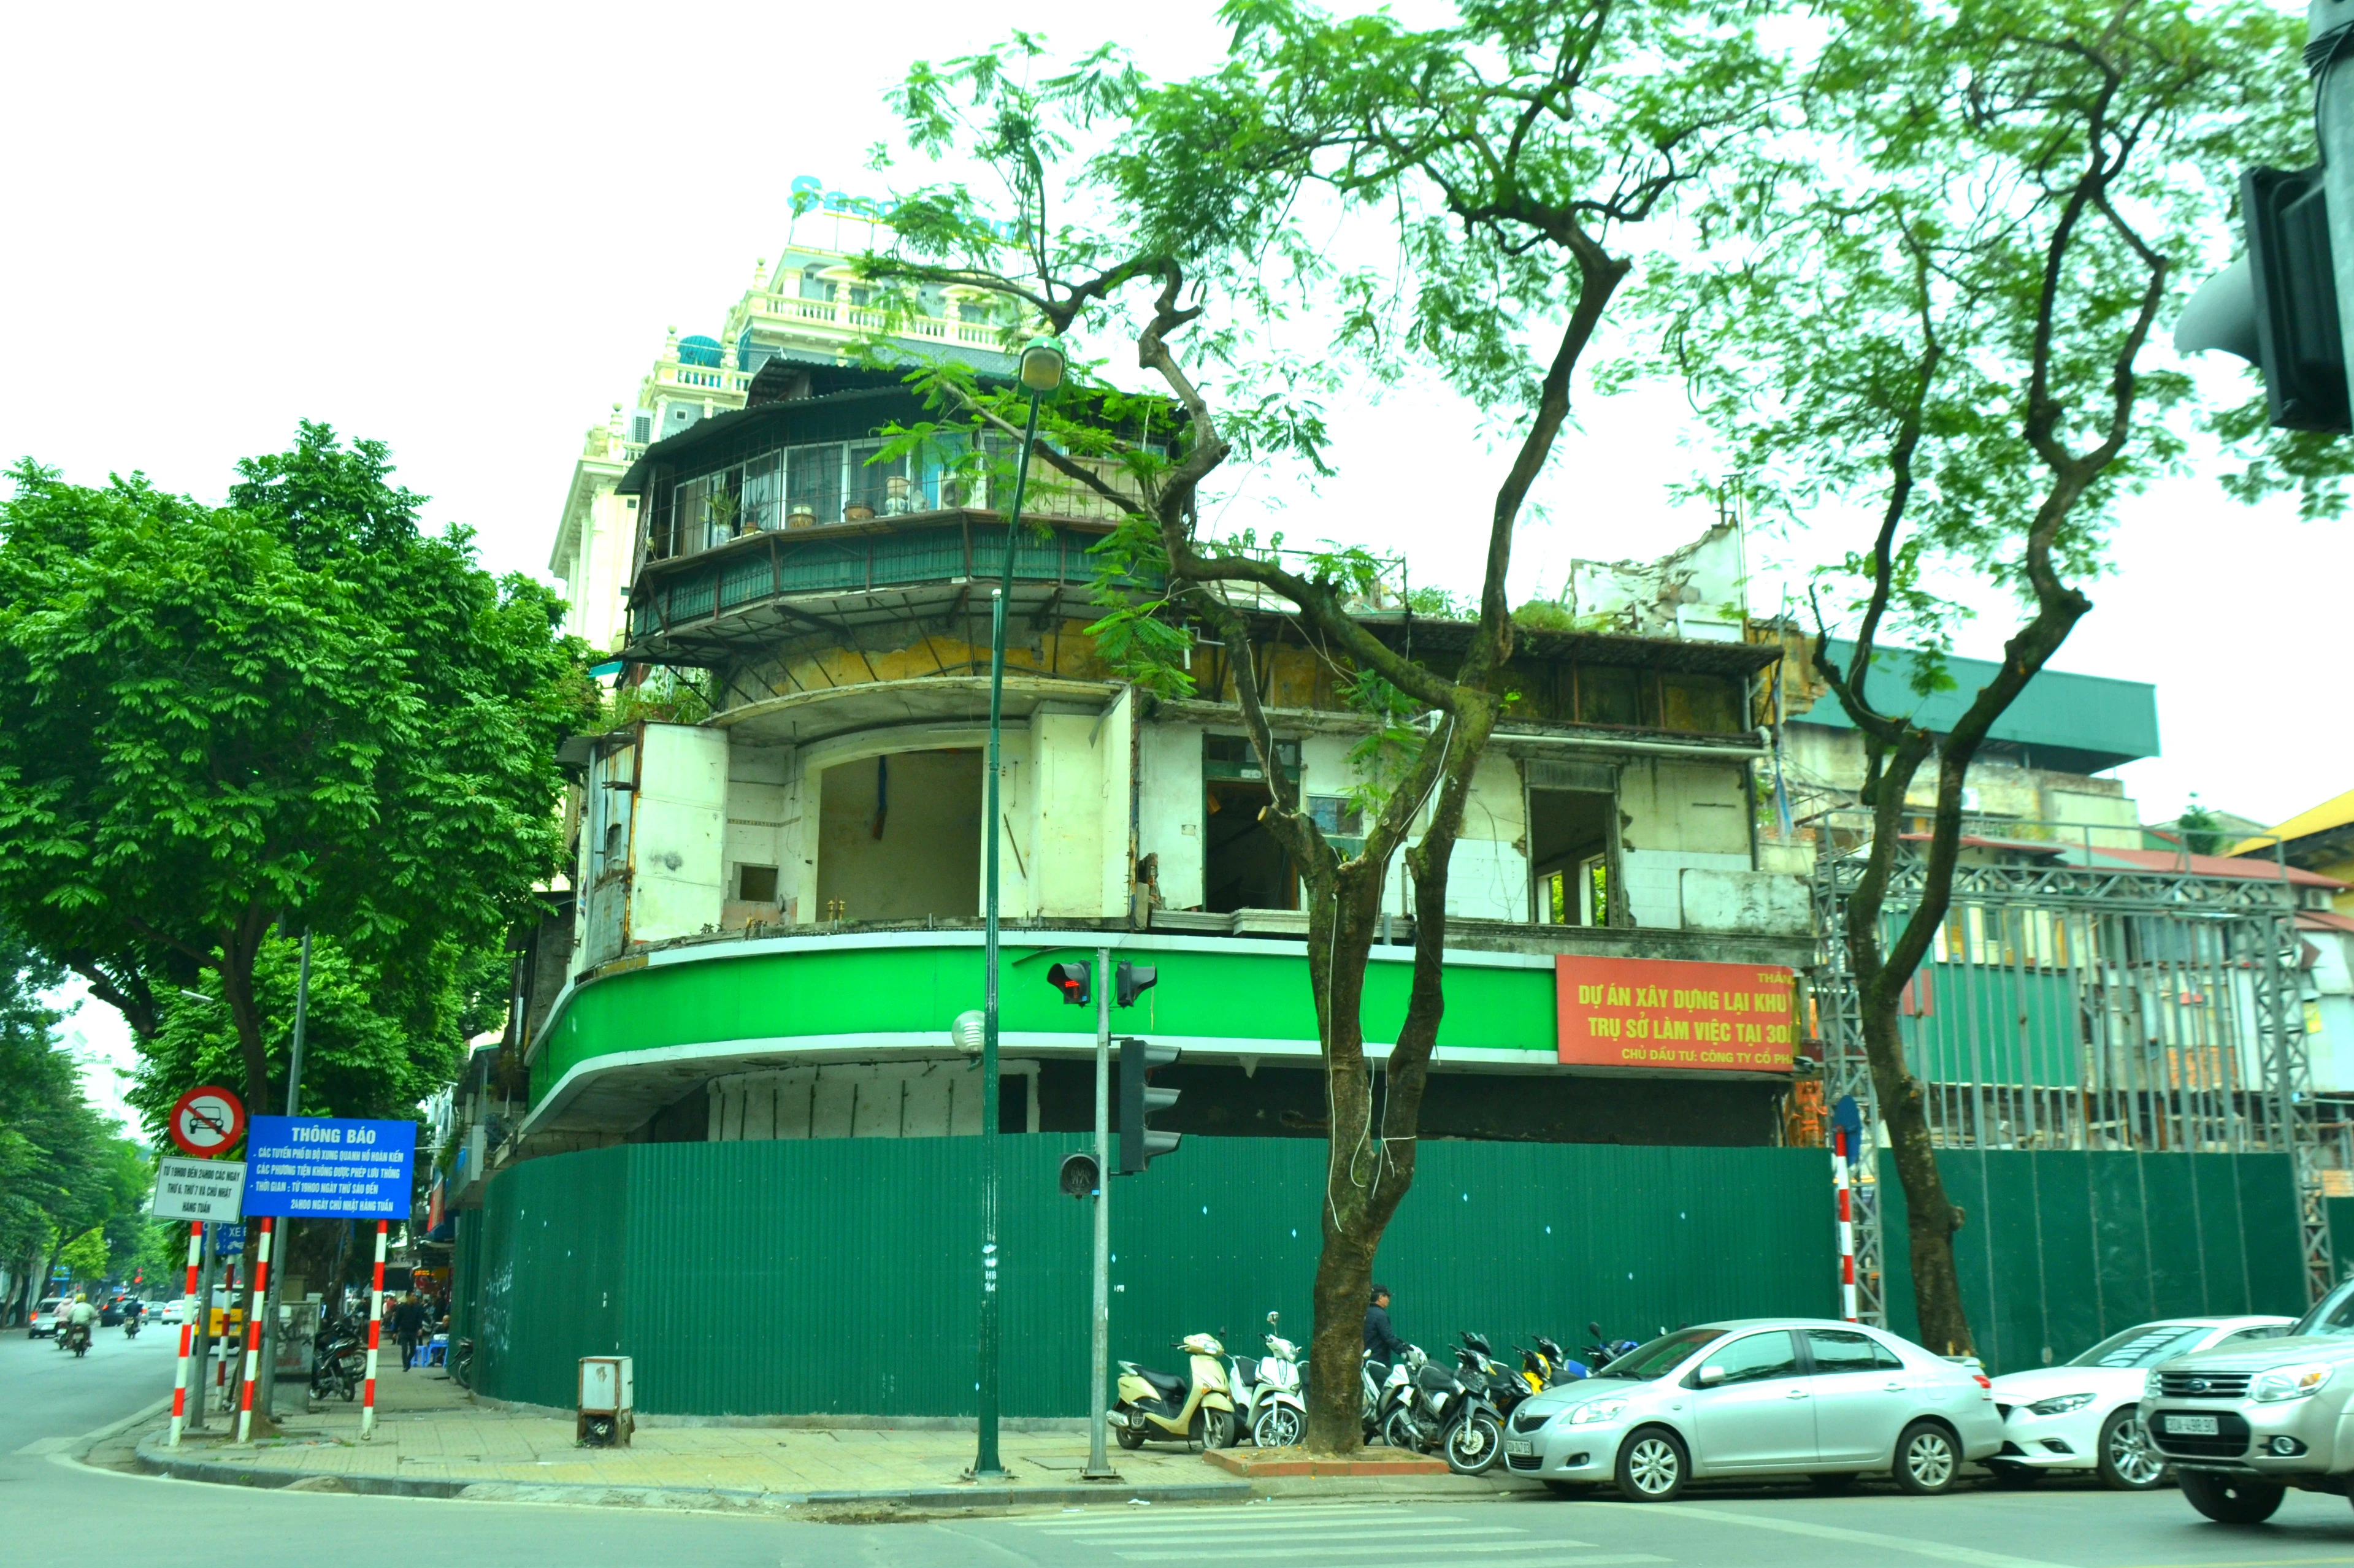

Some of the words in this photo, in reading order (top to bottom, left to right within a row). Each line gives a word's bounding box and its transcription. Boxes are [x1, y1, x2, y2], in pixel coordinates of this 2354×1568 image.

[1578, 984, 1604, 1009] DỰ
[1607, 982, 1631, 1006] ÁN
[1635, 984, 1669, 1008] XÂY
[1673, 989, 1719, 1013] DỰNG
[1723, 992, 1750, 1015] LẠI
[1754, 993, 1787, 1012] KHU
[1587, 1017, 1621, 1042] TRỤ
[1626, 1011, 1650, 1039] SỞ
[1653, 1016, 1690, 1041] LÀM
[1693, 1018, 1731, 1046] VIỆC
[1735, 1023, 1762, 1047] TẠI
[1621, 1044, 1647, 1060] CHỦ
[1678, 1050, 1698, 1063] TƯ:
[1700, 1049, 1735, 1063] CÔNG
[1736, 1053, 1752, 1063] TY
[1754, 1047, 1771, 1065] CỔ
[291, 1125, 341, 1143] THÔNG
[346, 1126, 377, 1144] BÁO
[258, 1145, 272, 1158] CÁC
[272, 1145, 292, 1159] TUYẾN
[292, 1146, 306, 1160] PHỐ
[312, 1147, 321, 1162] BỘ
[321, 1150, 339, 1161] XUNG
[339, 1150, 361, 1161] QUANH
[370, 1150, 388, 1162] HOÀN
[388, 1149, 404, 1163] KIẾM
[163, 1166, 171, 1176] TỪ
[171, 1167, 187, 1178] 19H00
[186, 1166, 198, 1179] ĐẾN
[215, 1168, 226, 1180] CÁC
[226, 1170, 240, 1182] NGÀY
[256, 1162, 270, 1175] CÁC
[270, 1165, 296, 1176] PHƯƠNG
[297, 1163, 312, 1178] TIỆN
[312, 1164, 333, 1177] KHÔNG
[333, 1166, 350, 1179] ĐƯỢC
[350, 1166, 367, 1178] PHÉP
[367, 1167, 380, 1178] LƯU
[380, 1166, 401, 1179] THÔNG
[167, 1182, 178, 1194] THỨ
[184, 1183, 195, 1195] THỨ
[194, 1185, 199, 1196] 7
[199, 1184, 206, 1196] VÀ
[206, 1184, 218, 1197] CHỦ
[217, 1187, 232, 1199] NHẬT
[256, 1179, 270, 1192] THỜI
[291, 1180, 302, 1193] TỪ
[301, 1182, 320, 1193] 19H00
[320, 1181, 338, 1194] NGÀY
[338, 1182, 352, 1194] THỨ
[351, 1182, 365, 1195] SÁU
[366, 1182, 379, 1195] ĐẾN
[182, 1199, 197, 1212] HÀNG
[290, 1199, 312, 1210] 24H00
[311, 1198, 329, 1210] NGÀY
[329, 1196, 342, 1210] CHỦ
[342, 1198, 359, 1213] NHẬT
[359, 1198, 377, 1212] HÀNG
[228, 1227, 241, 1237] XE
